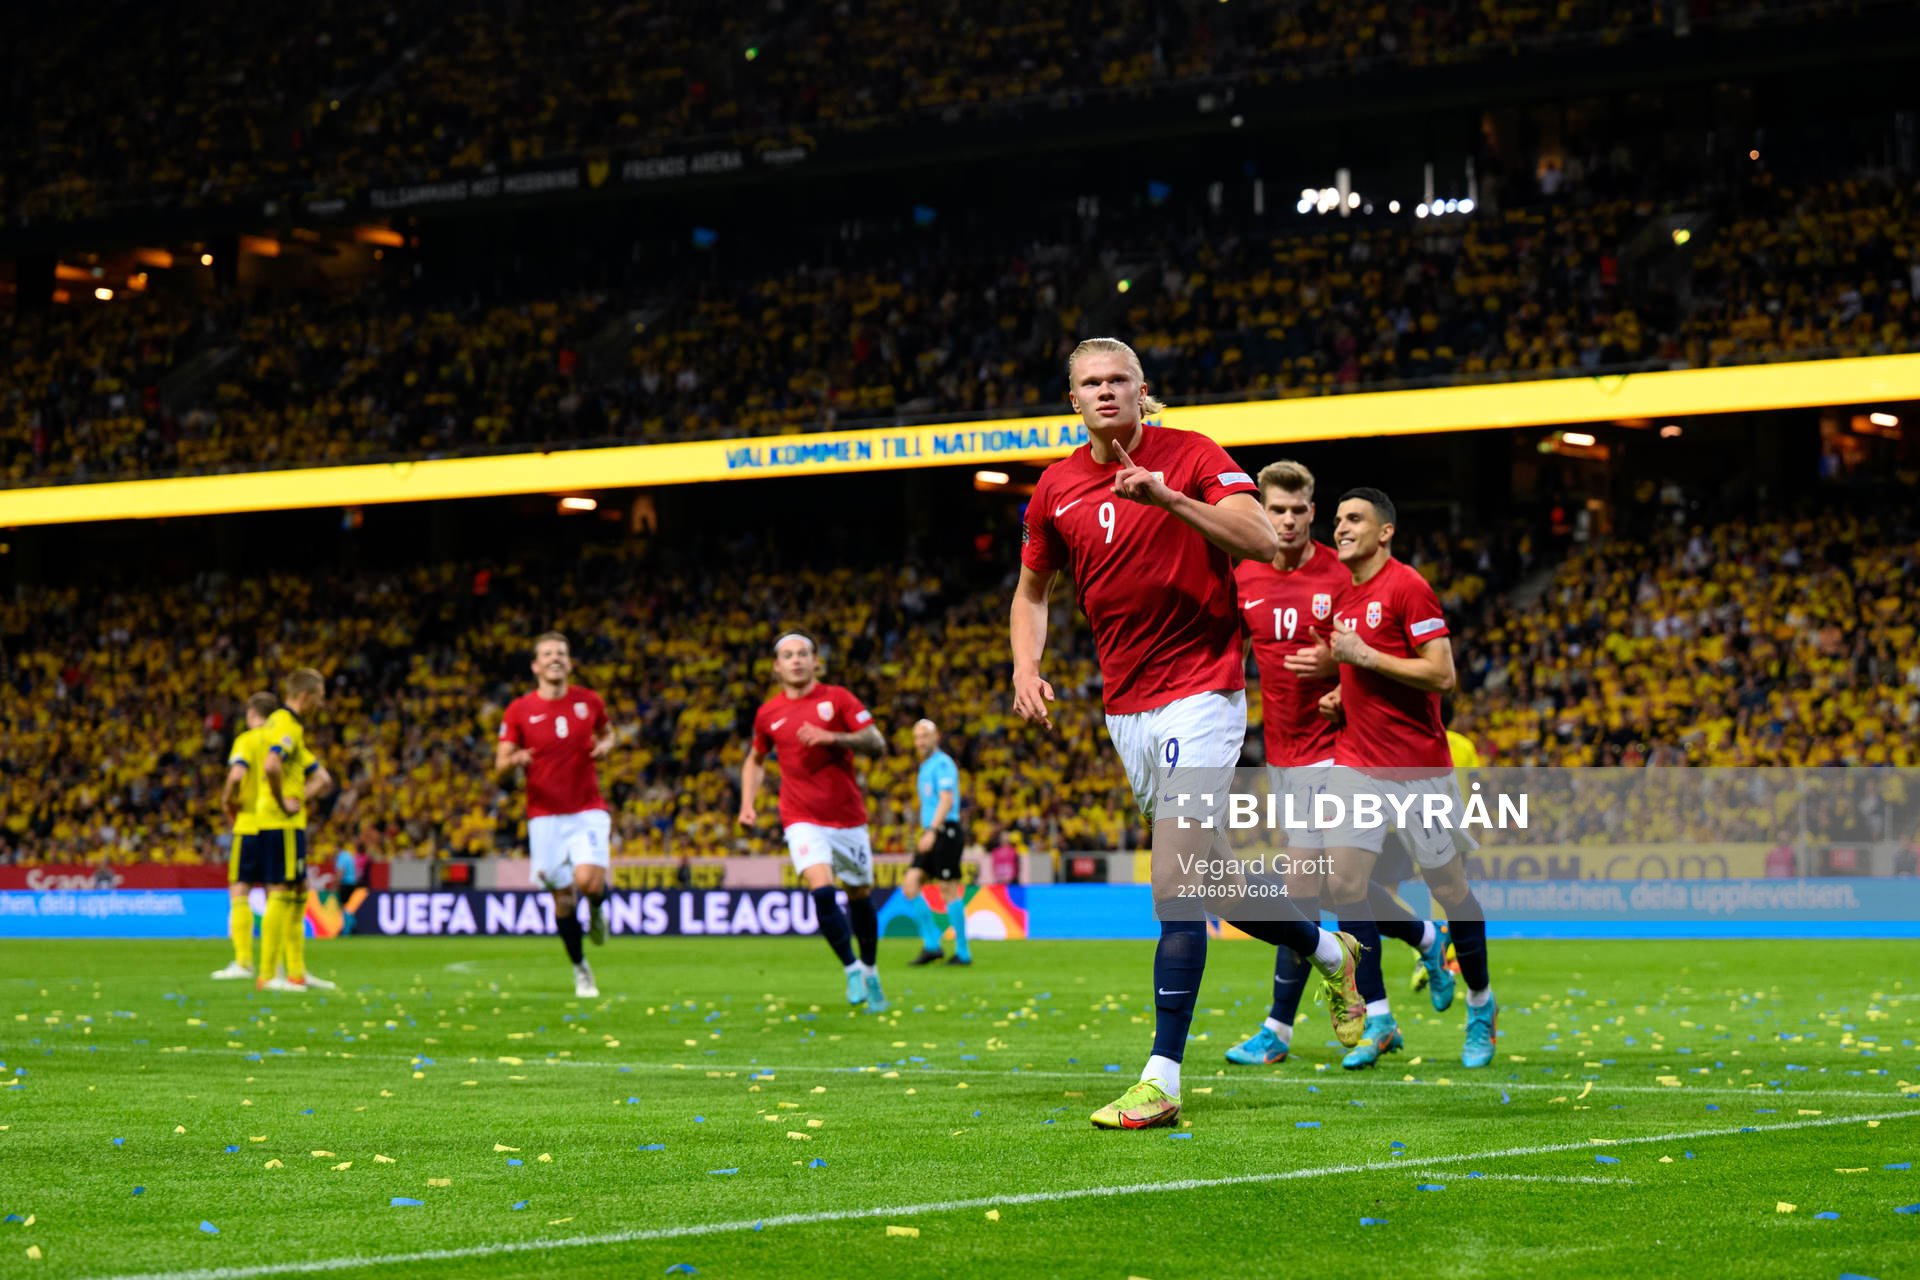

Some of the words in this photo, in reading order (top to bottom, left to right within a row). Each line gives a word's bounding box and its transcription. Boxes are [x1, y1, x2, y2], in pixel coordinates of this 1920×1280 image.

[1098, 502, 1116, 544] 9
[1273, 607, 1298, 641] 19
[554, 715, 570, 740] 8
[1165, 737, 1180, 779] 9
[378, 892, 477, 934] UEFA
[486, 892, 669, 934] NATONS
[1630, 877, 1687, 911] dela
